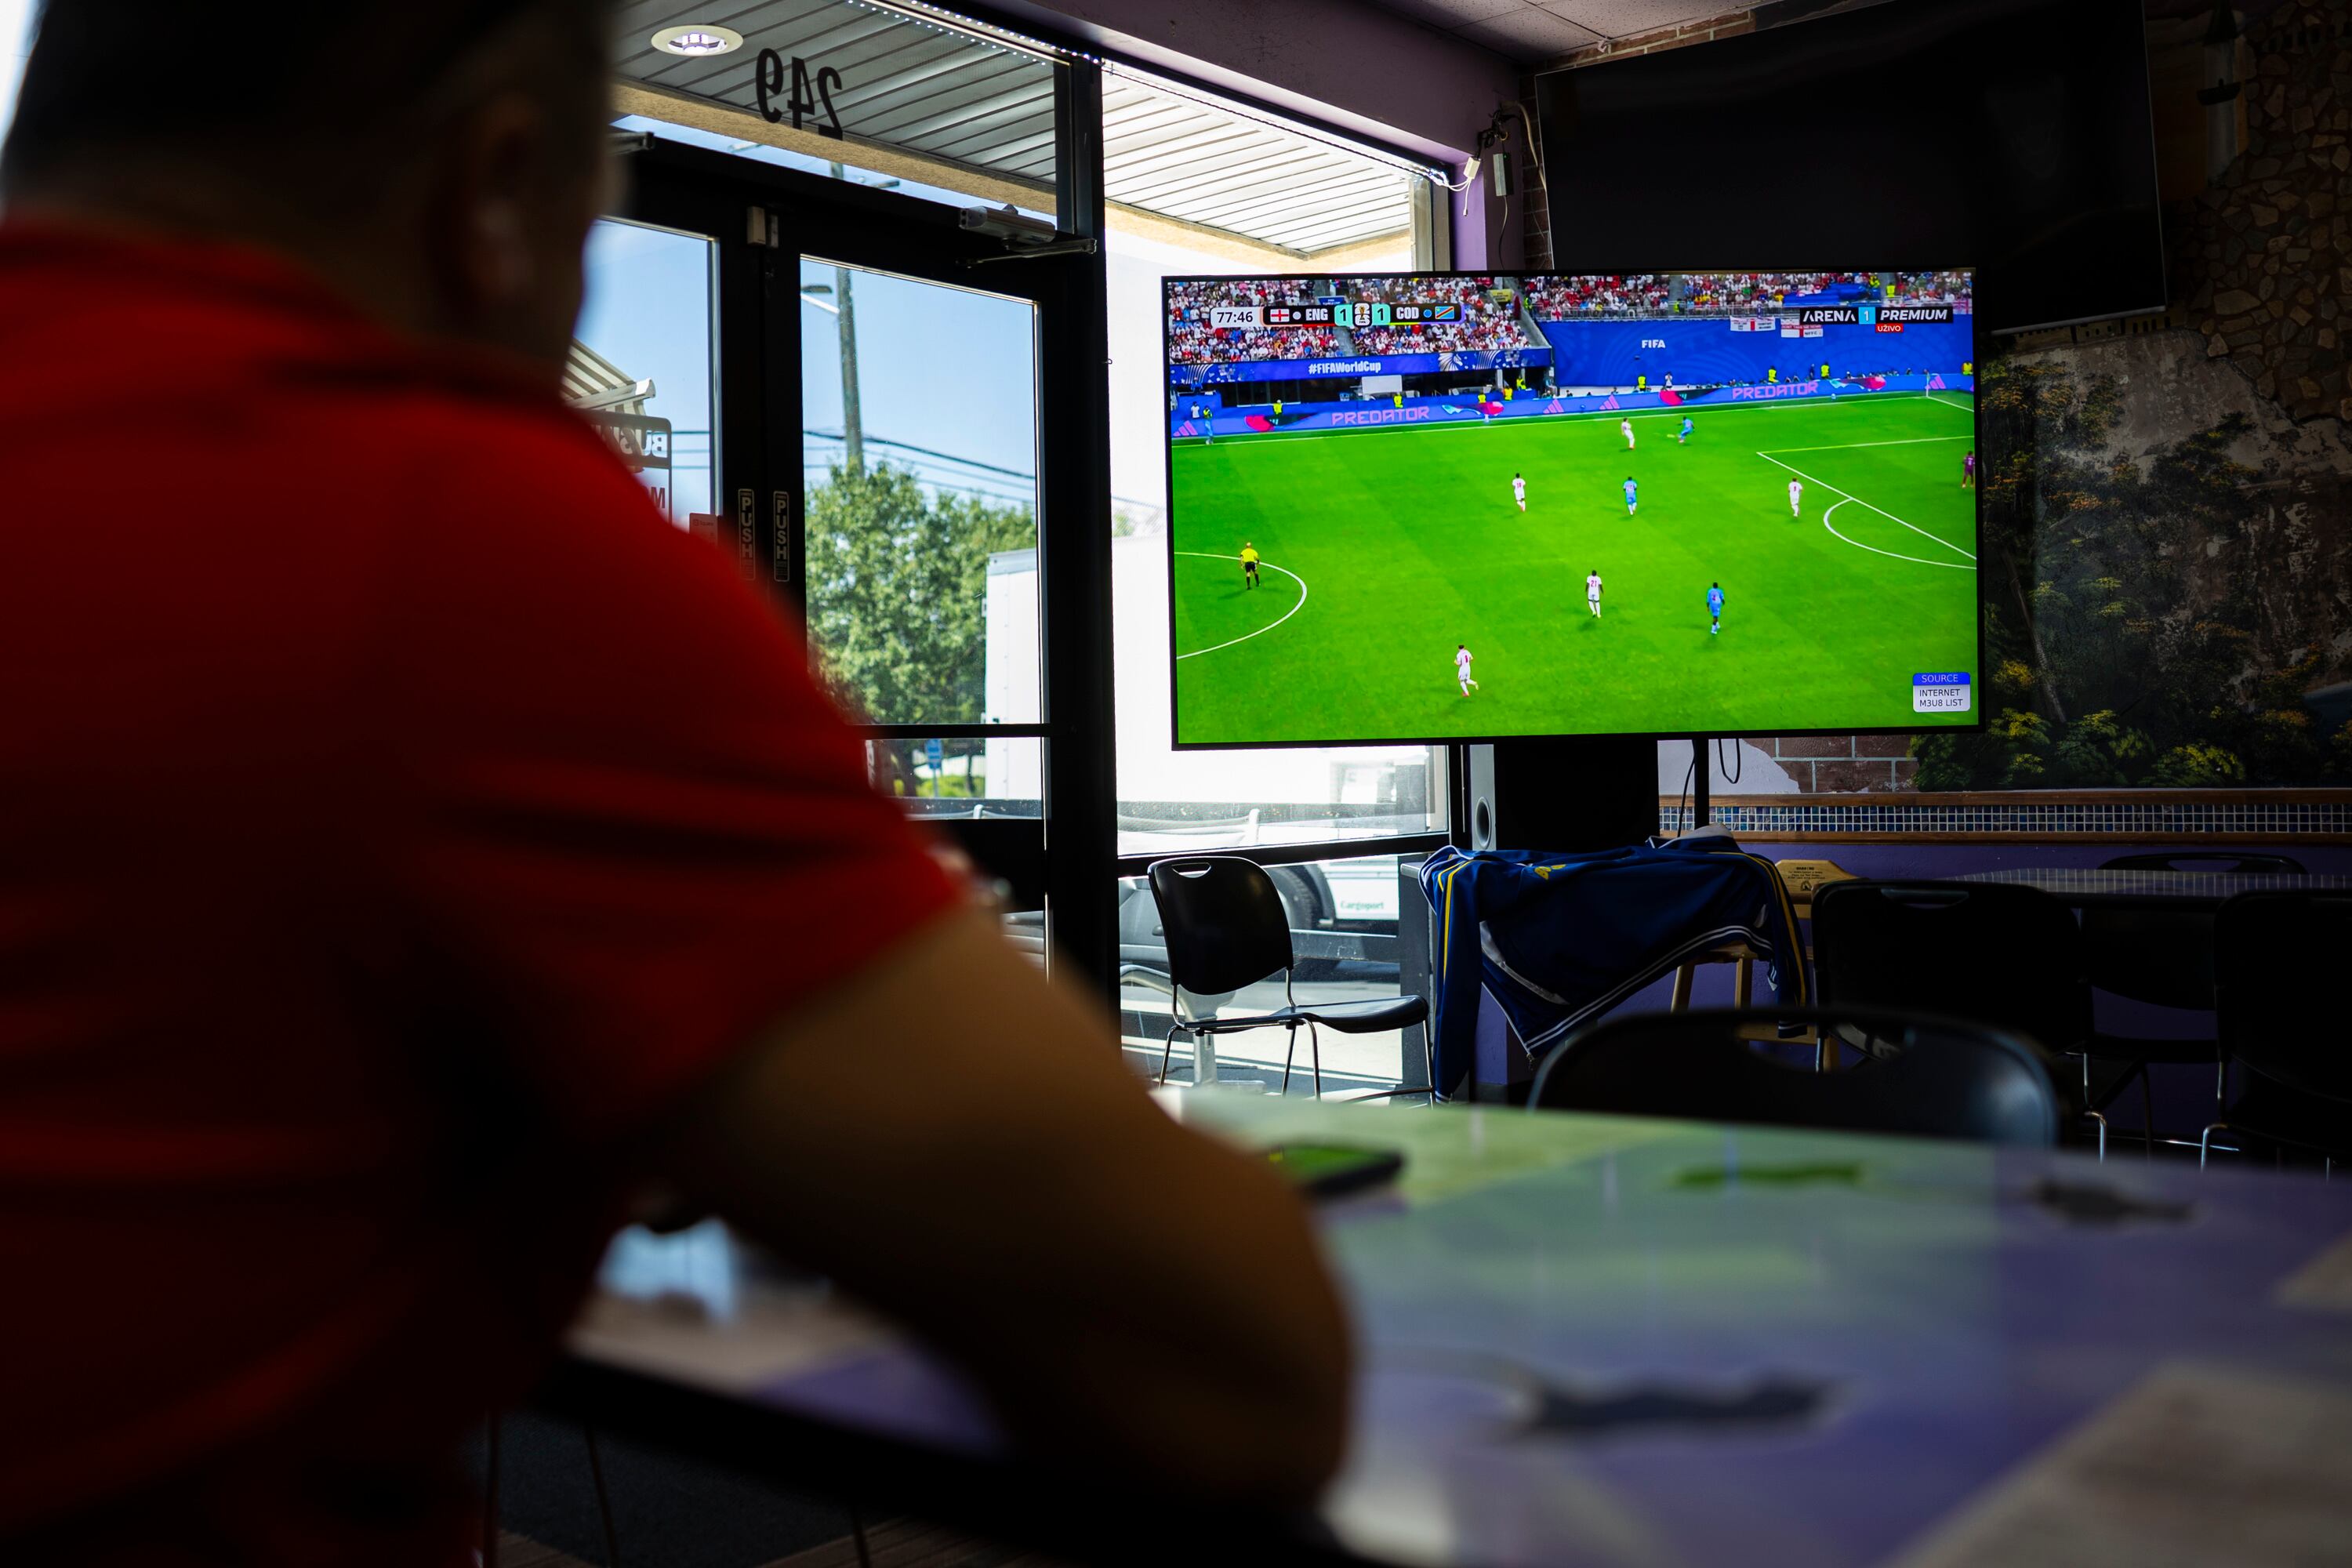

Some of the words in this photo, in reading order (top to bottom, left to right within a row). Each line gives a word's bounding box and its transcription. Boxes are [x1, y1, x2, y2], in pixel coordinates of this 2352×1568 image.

[1217, 311, 1254, 323] 77:46
[1305, 307, 1328, 321] ENG
[1340, 308, 1347, 321] 1
[1377, 307, 1384, 321] 1
[1396, 307, 1419, 320] COD
[1803, 310, 1856, 322] ARENA
[1864, 310, 1870, 321] 1
[1880, 309, 1947, 321] PREMIUM
[1877, 324, 1901, 332] UŽIVO
[1641, 339, 1666, 349] FIFA
[1308, 361, 1381, 375] #FIFAWorldCup
[1732, 381, 1819, 400] PREDATOR
[1331, 405, 1430, 426] PREDATOR
[741, 496, 753, 558] PUSH
[776, 499, 787, 560] PUSH
[1922, 674, 1958, 683] SOURCE
[1919, 688, 1961, 697] INTERNET
